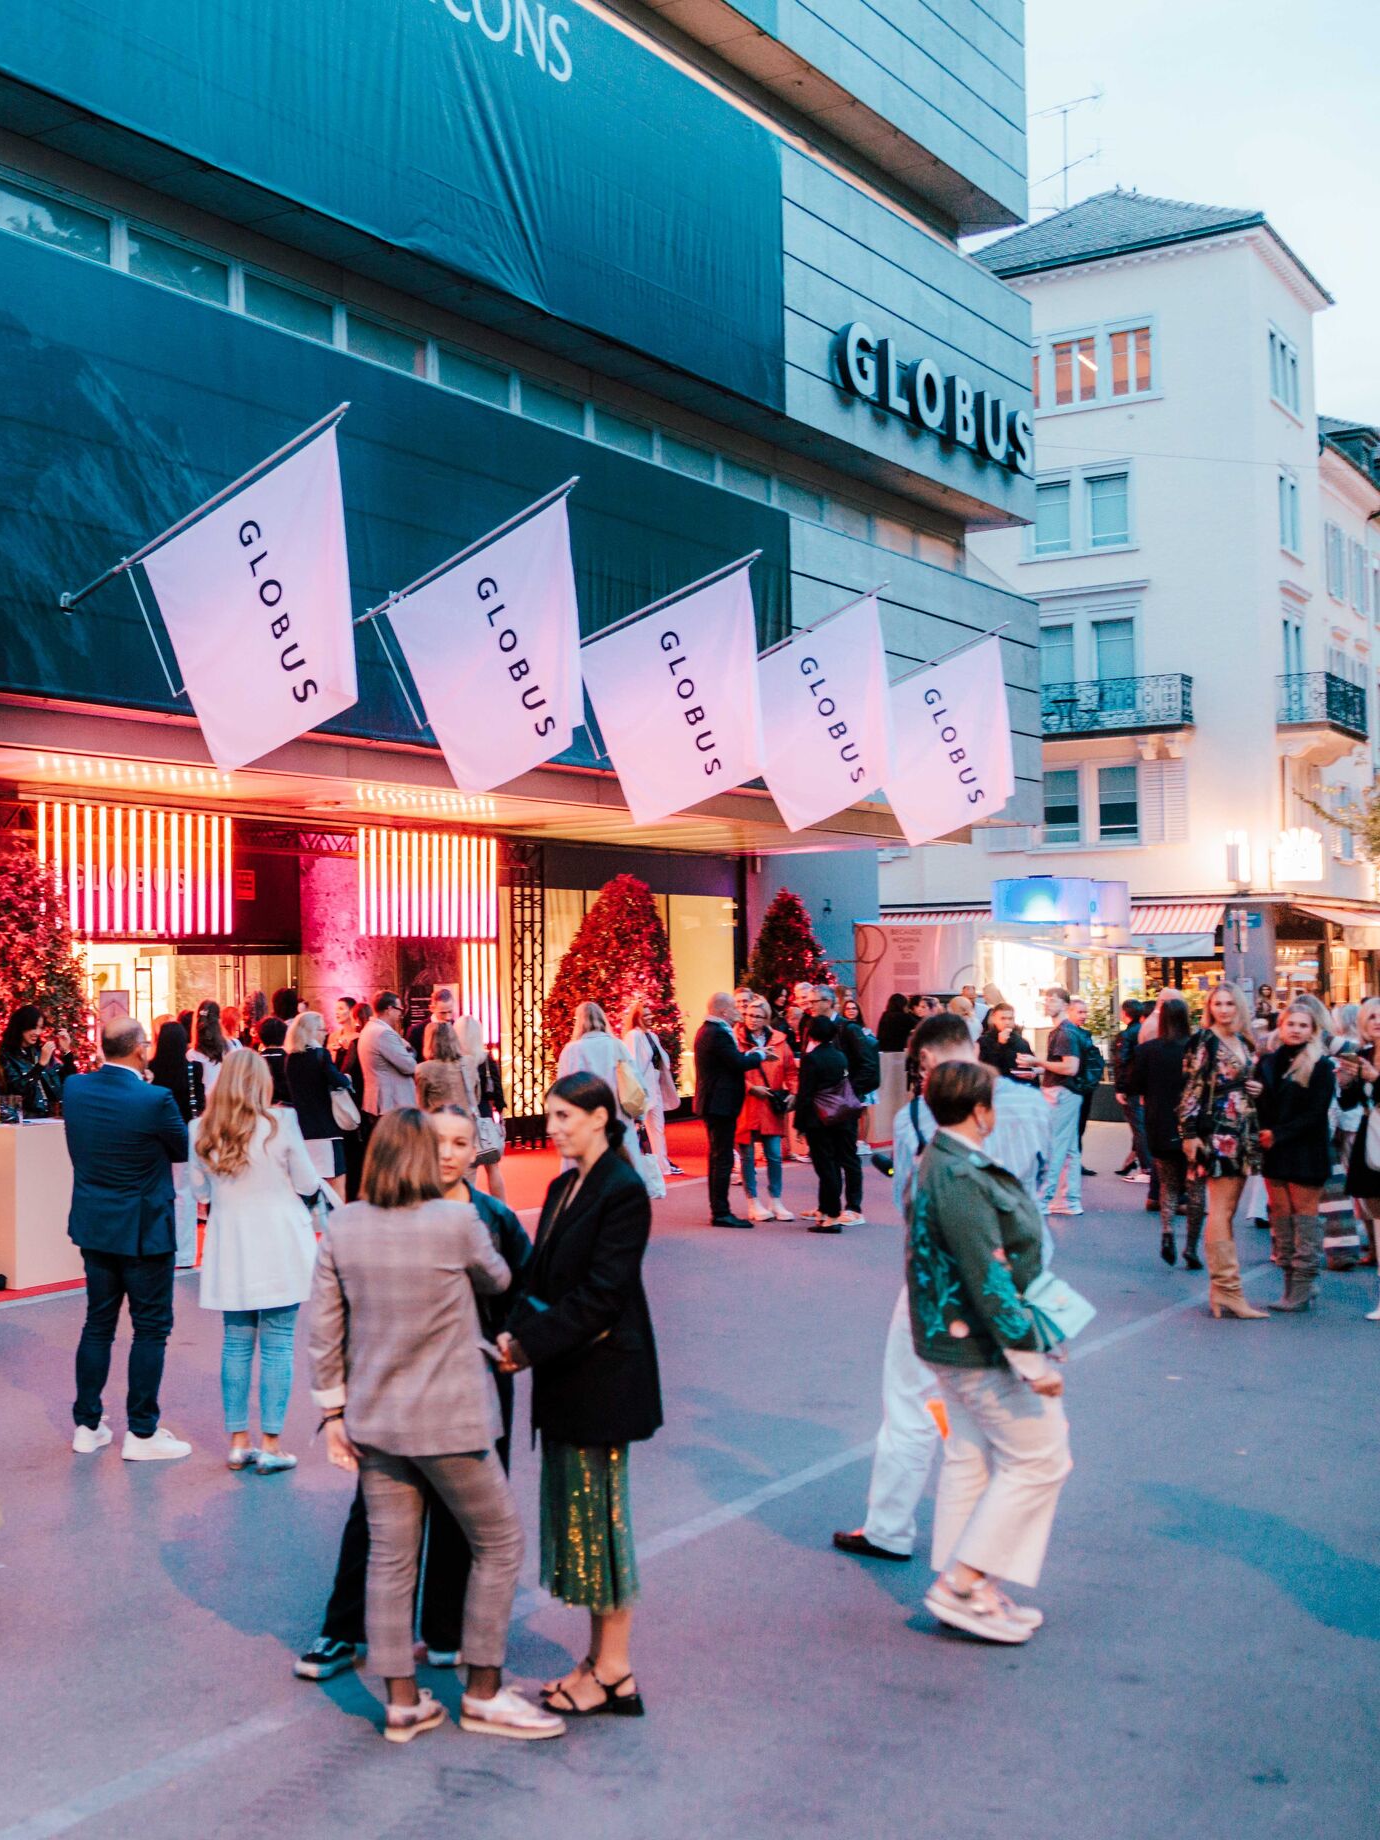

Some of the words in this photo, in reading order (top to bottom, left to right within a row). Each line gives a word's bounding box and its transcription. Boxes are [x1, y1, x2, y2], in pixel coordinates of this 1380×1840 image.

[429, 0, 573, 82] ONS
[837, 321, 1034, 474] GLOBUS
[239, 520, 318, 703] GLOBUS
[477, 577, 556, 737] GLOBUS
[660, 631, 722, 776] GLOBUS
[800, 657, 866, 783] GLOBUS
[924, 688, 985, 804] GLOBUS
